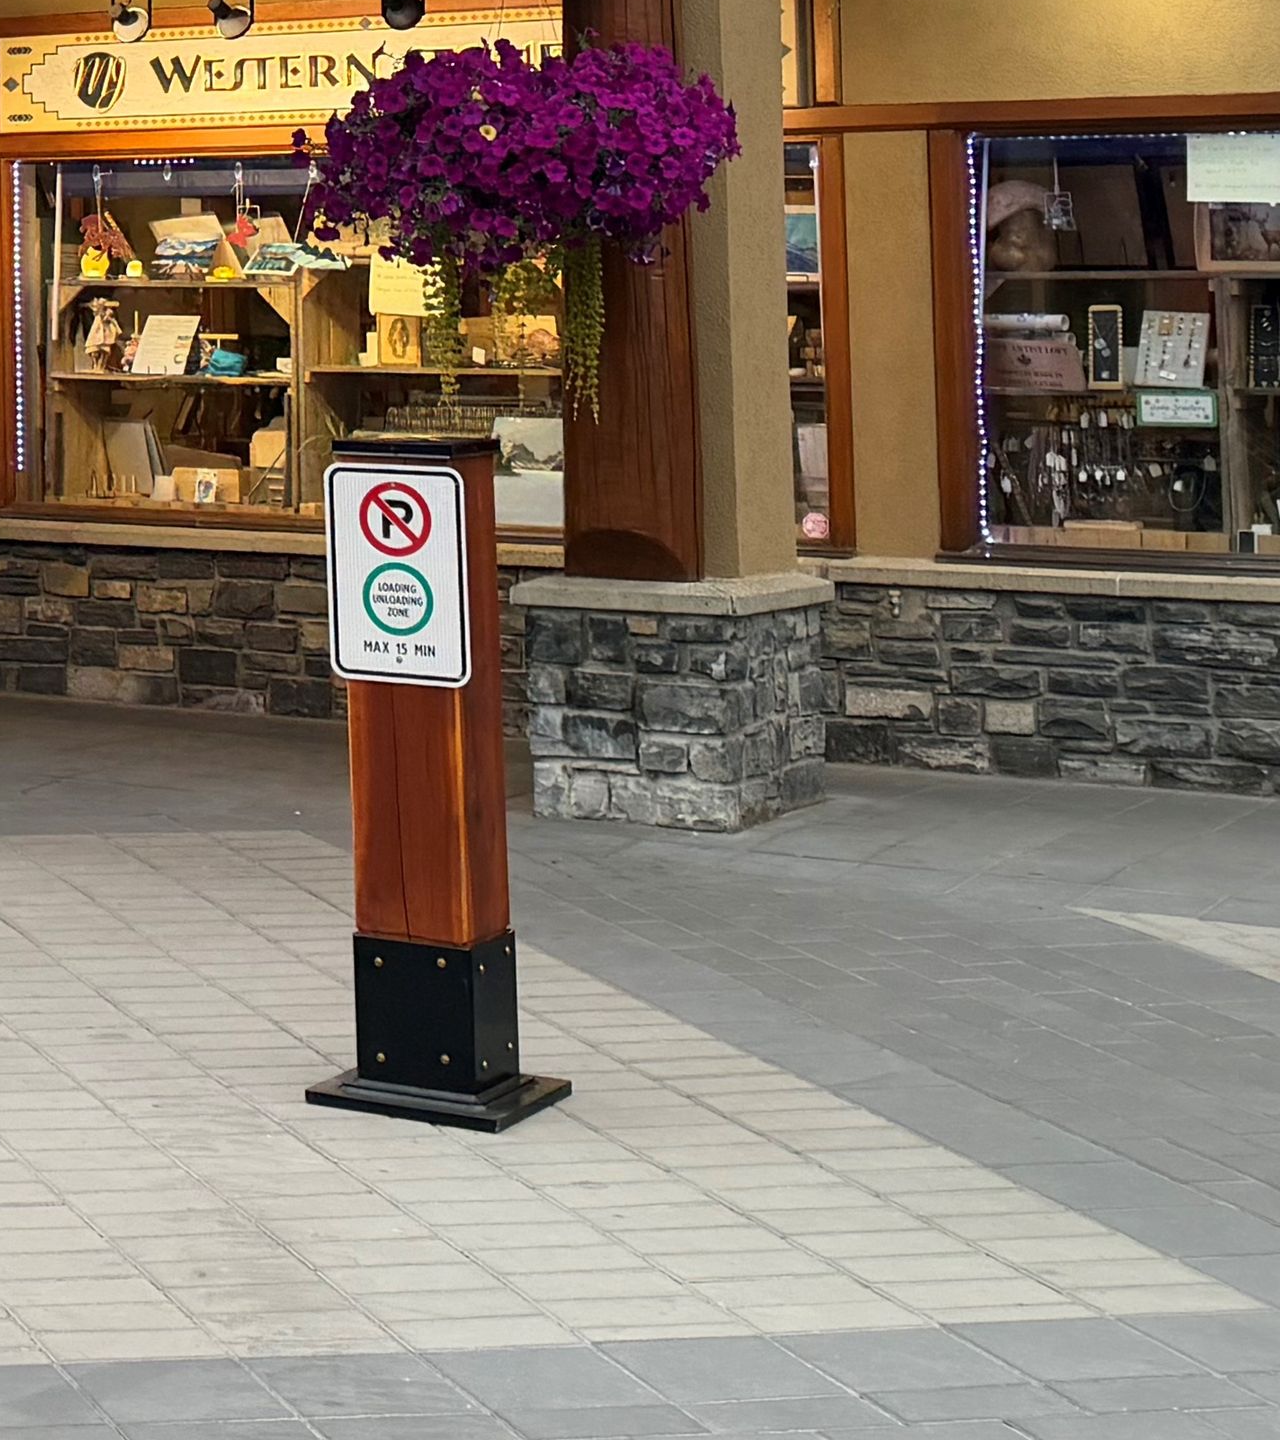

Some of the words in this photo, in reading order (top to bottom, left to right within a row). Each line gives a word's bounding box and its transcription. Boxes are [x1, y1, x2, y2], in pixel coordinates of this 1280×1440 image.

[149, 53, 376, 94] WESTERN
[378, 582, 417, 594] LOADING
[372, 594, 424, 608] UNLOADING
[387, 606, 410, 618] ZONE
[363, 640, 390, 654] MAX
[396, 643, 408, 655] 15
[414, 644, 436, 658] MIN
